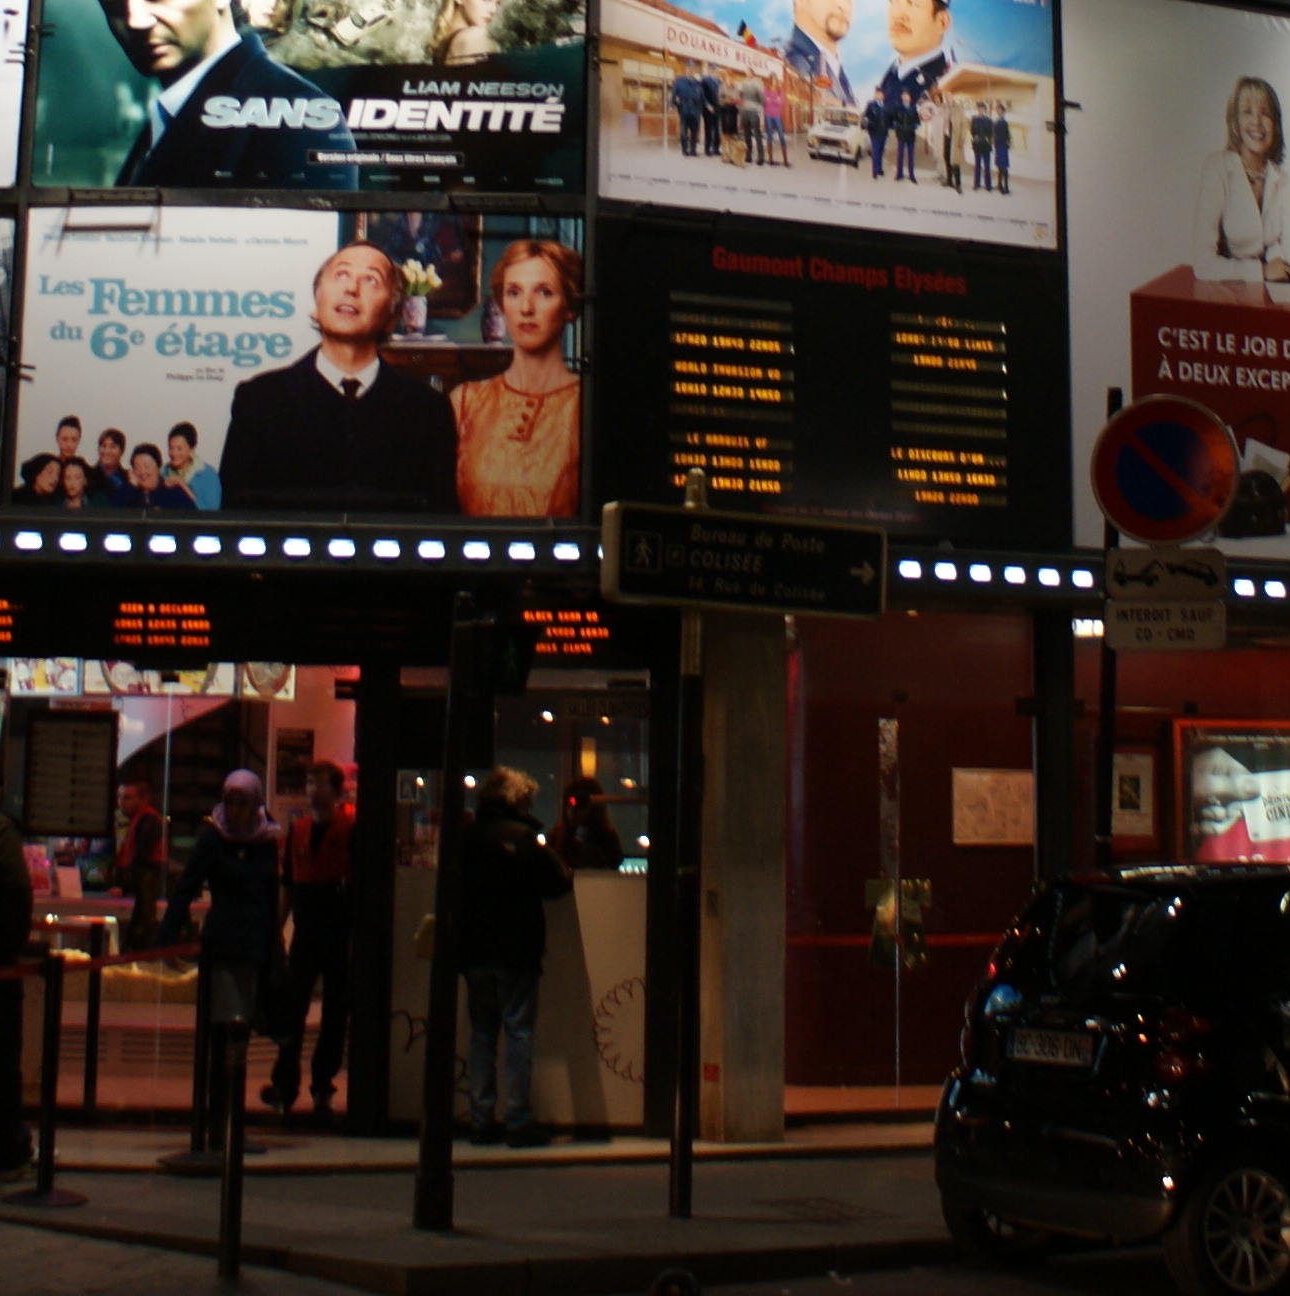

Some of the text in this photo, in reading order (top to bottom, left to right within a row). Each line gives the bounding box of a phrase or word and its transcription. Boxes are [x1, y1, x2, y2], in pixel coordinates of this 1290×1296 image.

[667, 27, 729, 58] DOUANES
[402, 81, 564, 97] LIAM NEESON
[201, 96, 566, 134] SANS IDENTITÉ
[711, 246, 967, 296] Gaumont Champs Elysées
[39, 275, 296, 318] Les Femmes
[50, 320, 83, 341] du
[155, 322, 293, 368] étage
[1158, 327, 1209, 350] C'EST
[1216, 333, 1235, 354] LE
[1241, 335, 1277, 358] JOB
[1158, 353, 1173, 380] À
[1179, 362, 1230, 386] DEUX
[691, 524, 825, 554] Bureau de Poste
[690, 549, 764, 572] COLISÉE
[1117, 608, 1213, 622] INTERDIT SAUF
